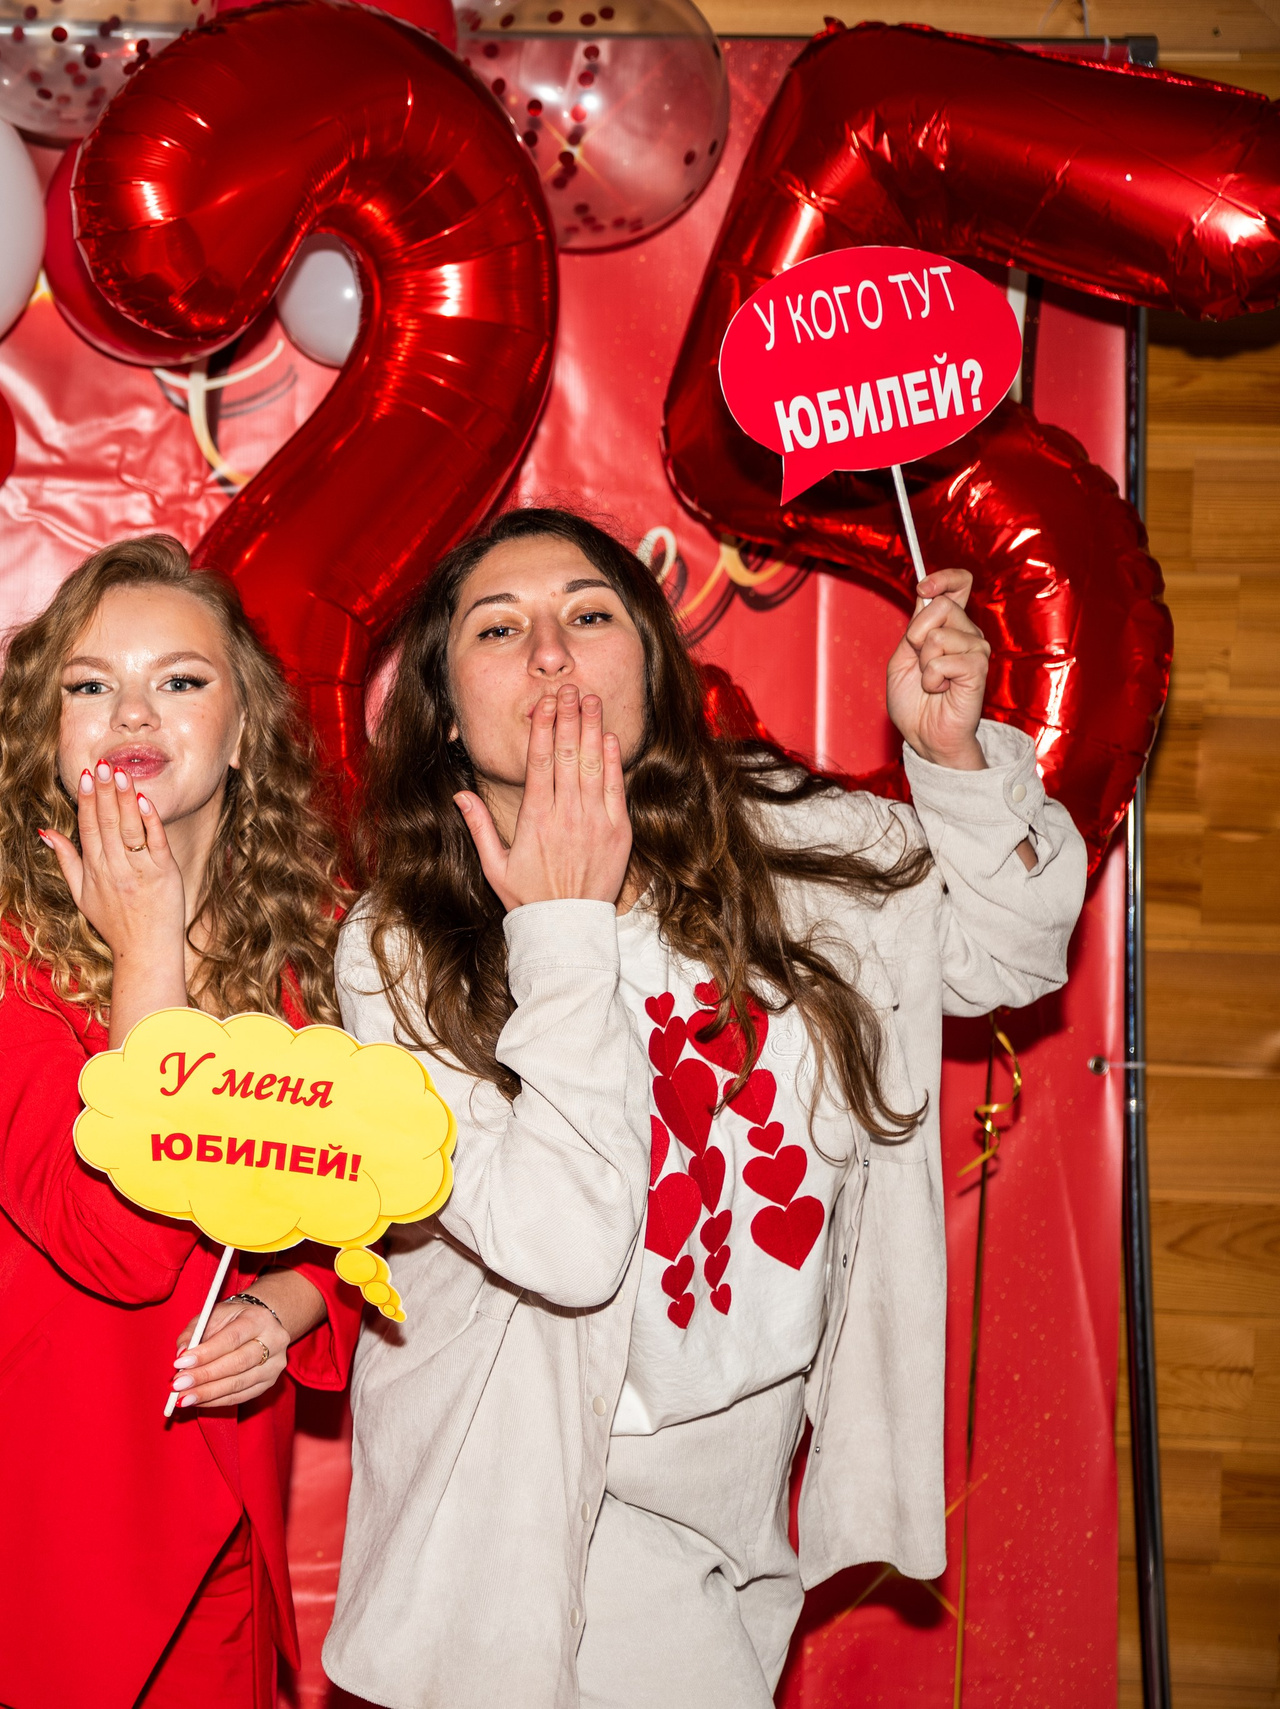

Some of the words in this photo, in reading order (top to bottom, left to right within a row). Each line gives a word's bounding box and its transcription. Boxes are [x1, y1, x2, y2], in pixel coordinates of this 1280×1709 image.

[753, 299, 775, 351] У
[786, 279, 883, 343] КОГО
[888, 265, 954, 320] ТУТ
[774, 352, 983, 453] ЮБИЛЕЙ?
[159, 1052, 216, 1097] У
[211, 1068, 334, 1109] меня
[150, 1132, 362, 1182] ЮБИЛЕЙ!
